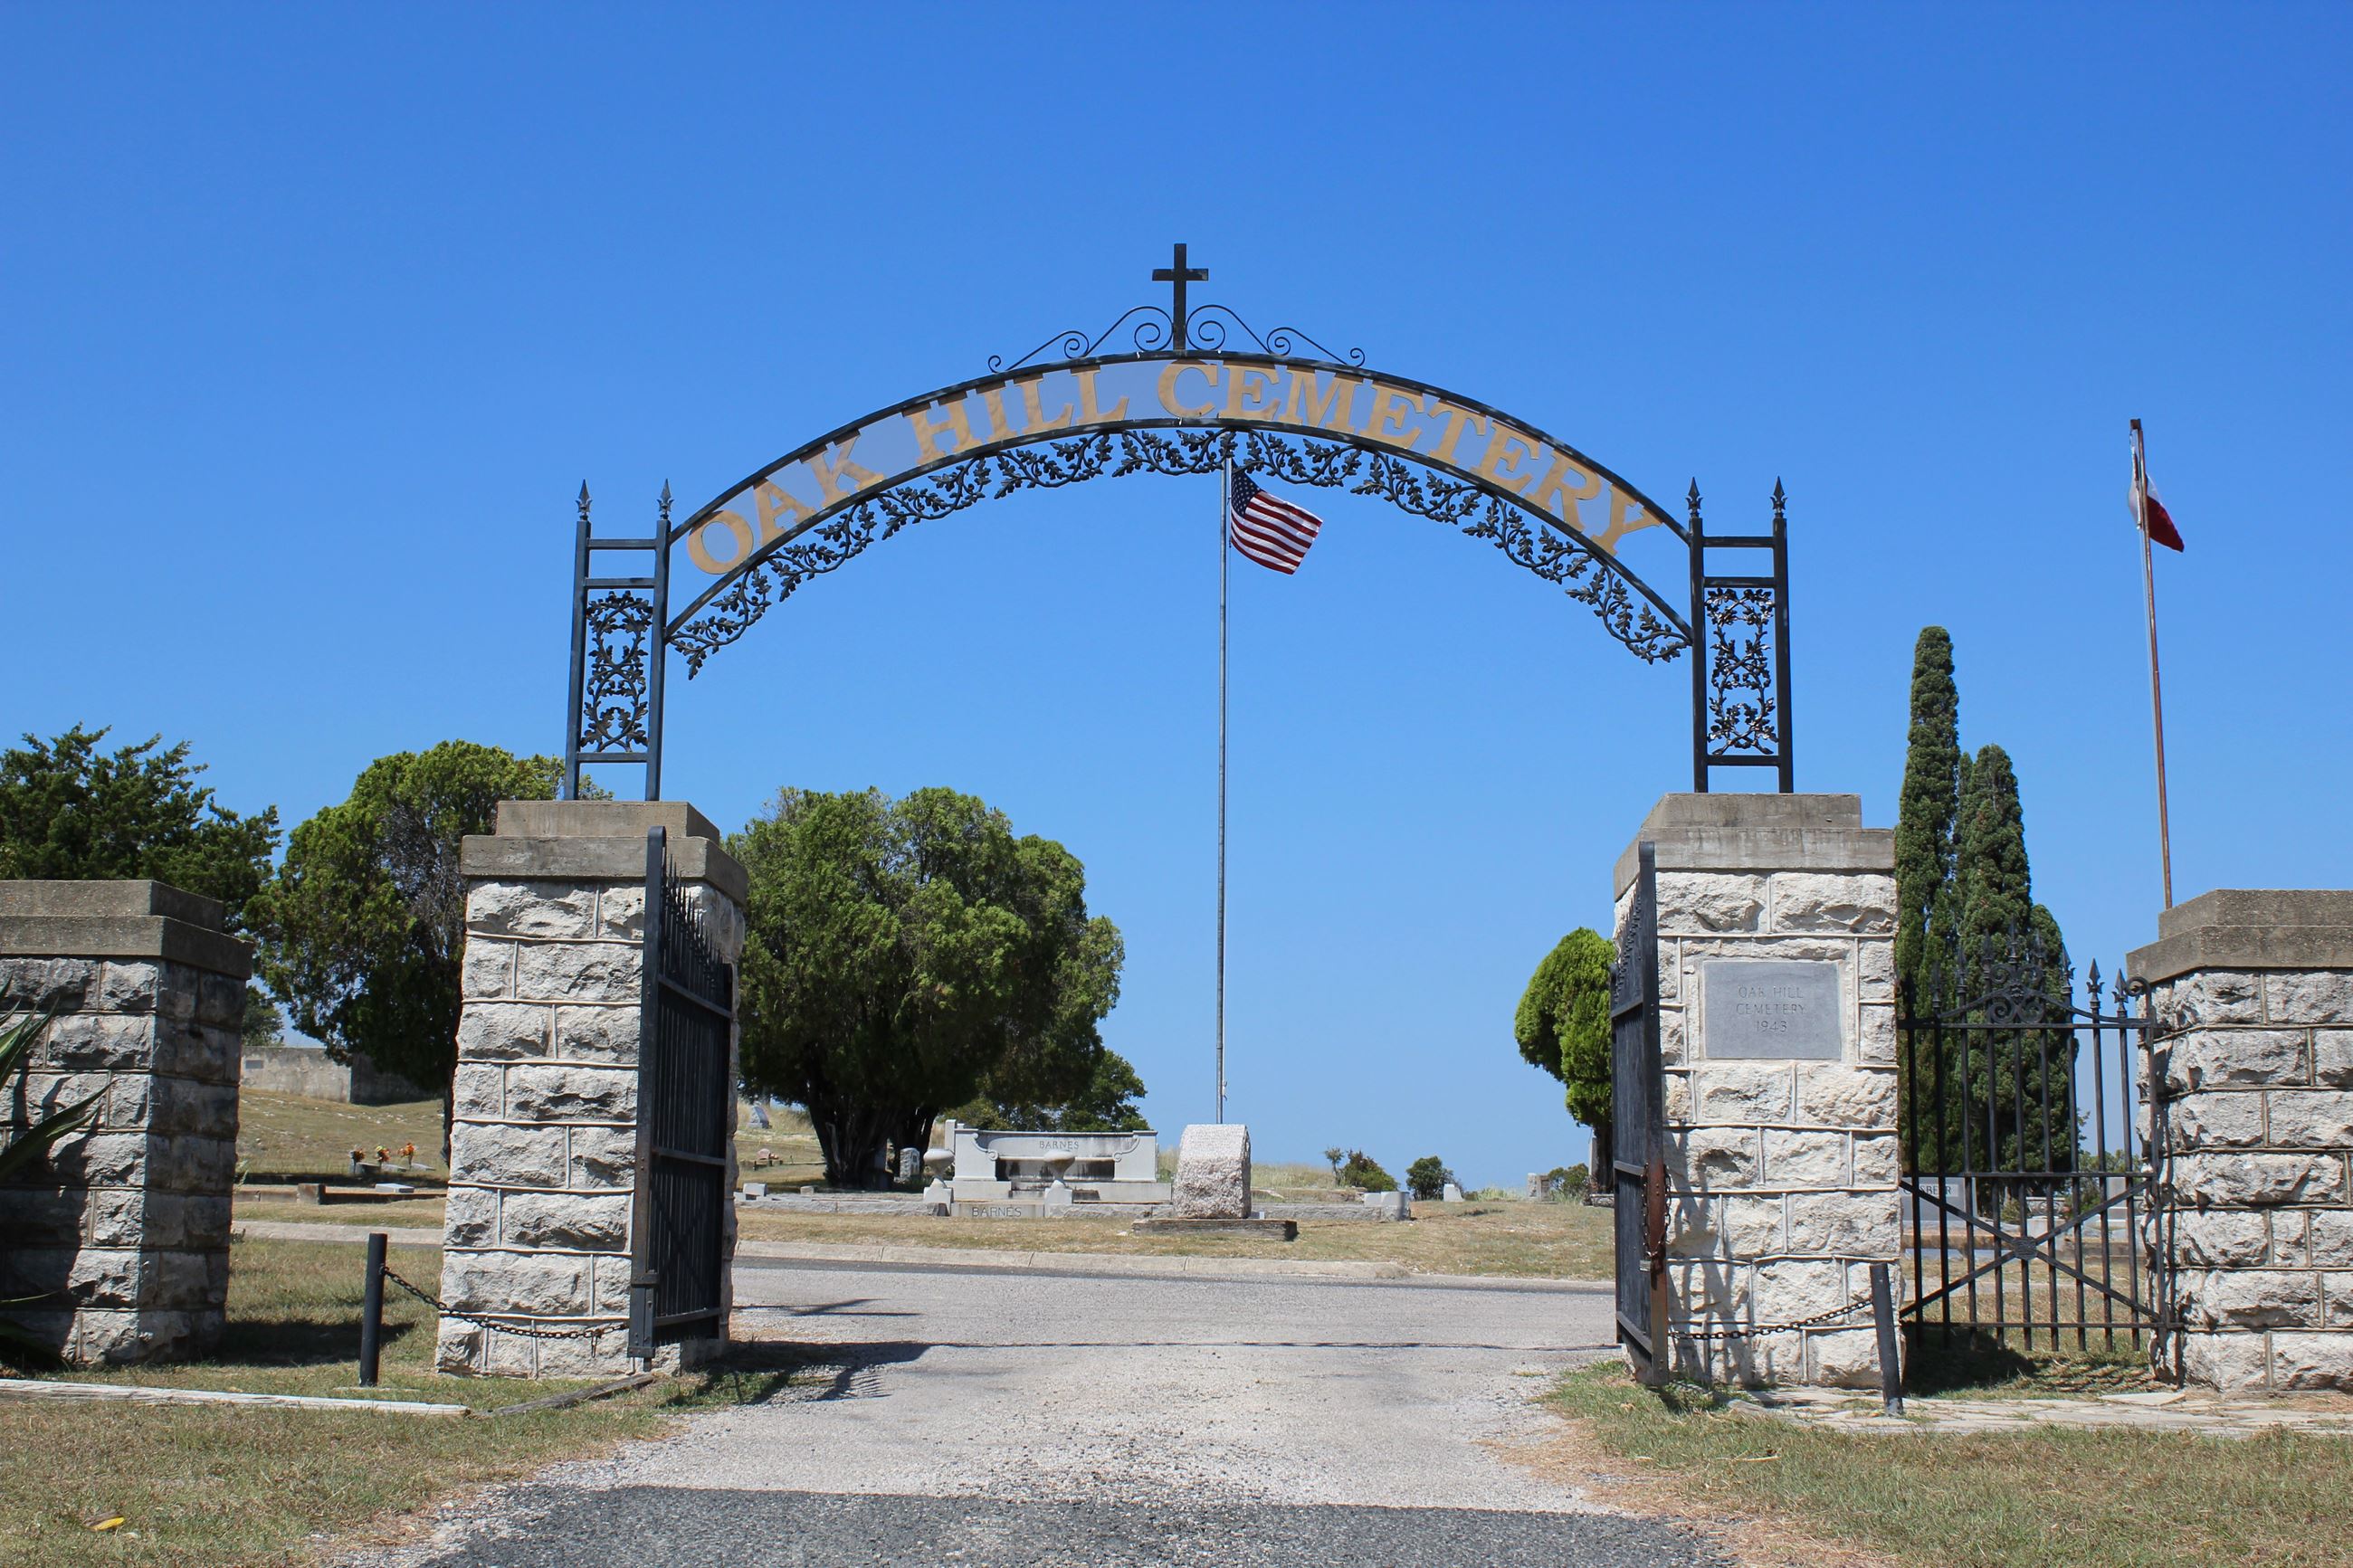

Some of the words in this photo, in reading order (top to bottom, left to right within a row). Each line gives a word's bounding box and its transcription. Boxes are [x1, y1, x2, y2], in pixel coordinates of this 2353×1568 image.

[685, 429, 885, 575] OAK
[899, 364, 1129, 466] HILL
[1157, 358, 1664, 556] CEMETERY
[1738, 986, 1767, 999] OAK
[1773, 986, 1804, 999] HILL
[1736, 1003, 1805, 1015] CEMETERY
[1757, 1020, 1787, 1032] 1943
[1038, 1140, 1080, 1150] BARNES
[971, 1206, 1023, 1218] BARNES
